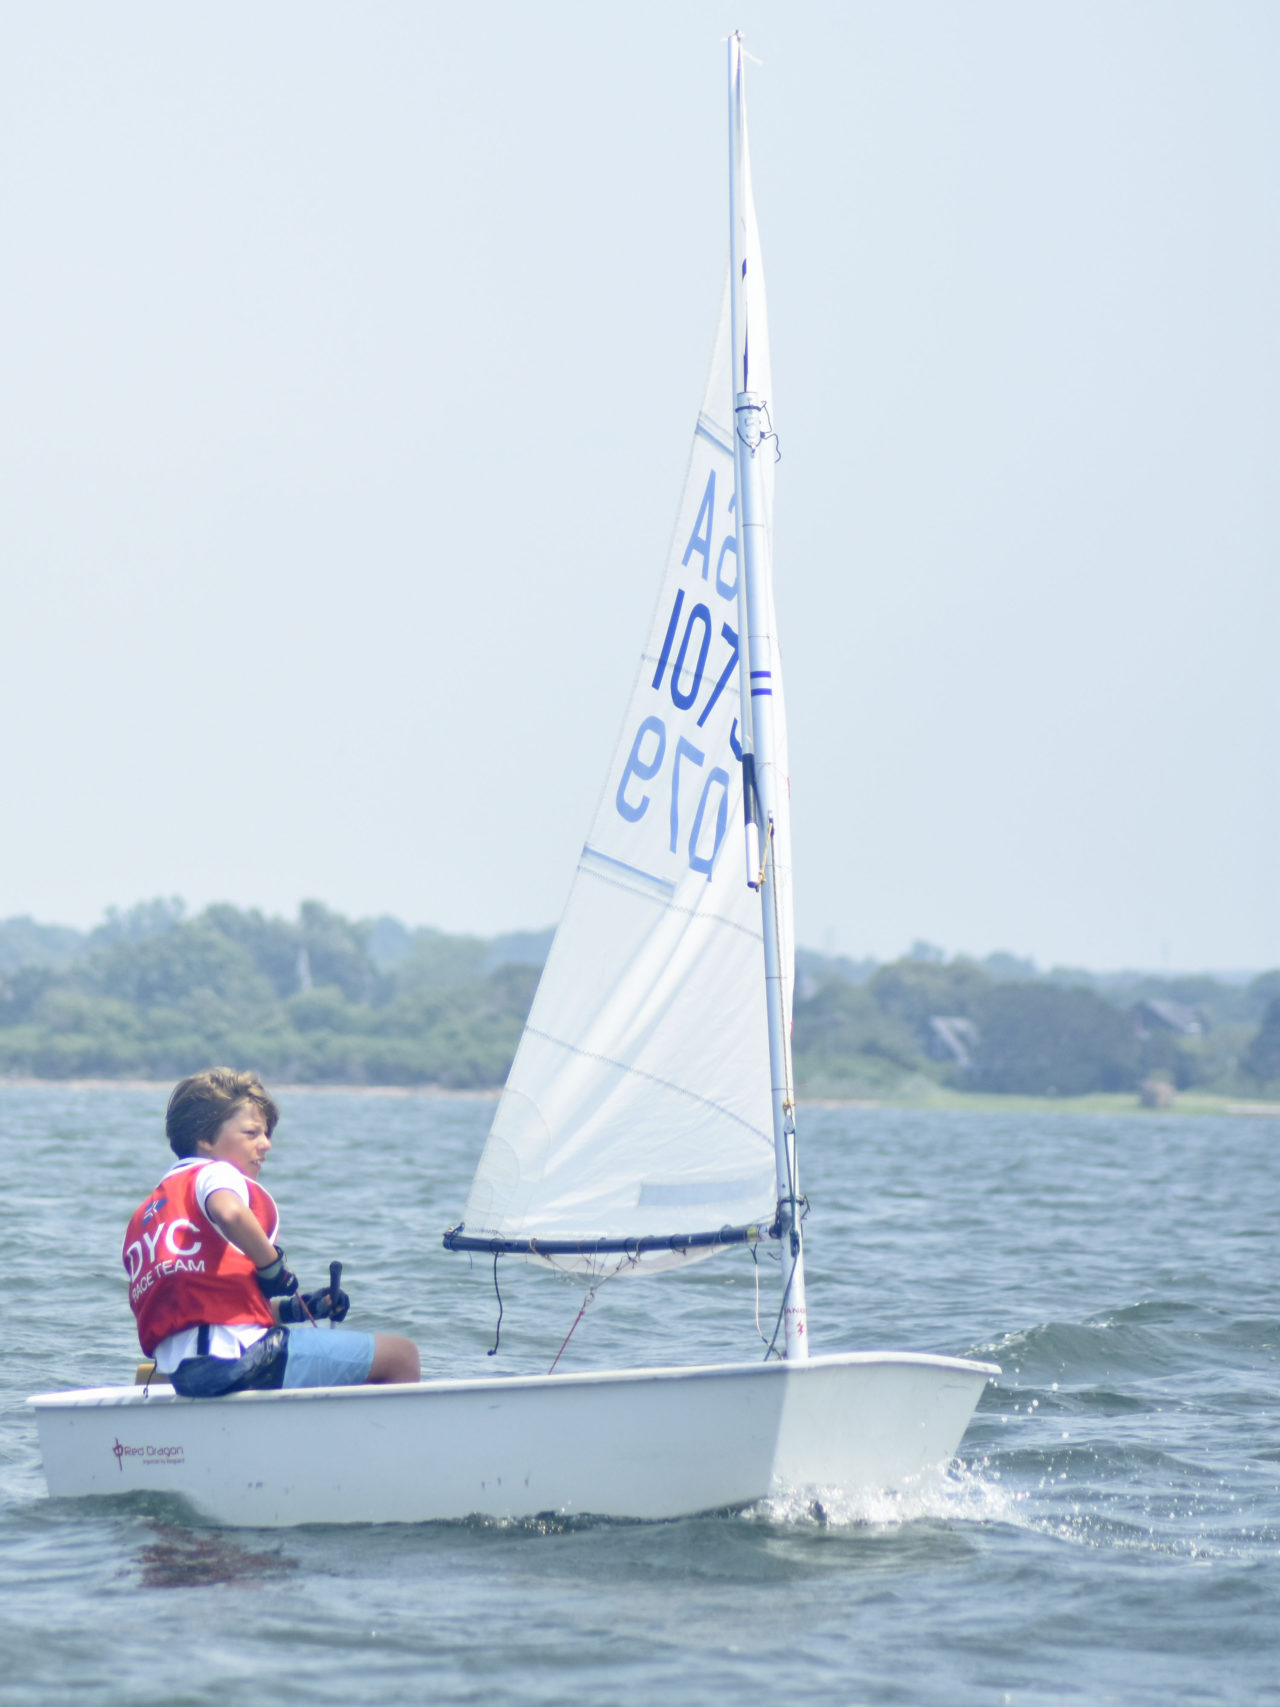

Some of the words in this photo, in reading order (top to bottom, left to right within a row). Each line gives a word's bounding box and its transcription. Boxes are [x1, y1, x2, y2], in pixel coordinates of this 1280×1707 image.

[651, 588, 742, 762] 107
[126, 1218, 202, 1283] DYC
[132, 1270, 155, 1303] RACE
[154, 1259, 206, 1278] TEAM
[124, 1446, 144, 1456] Red
[146, 1446, 184, 1457] Dragon
